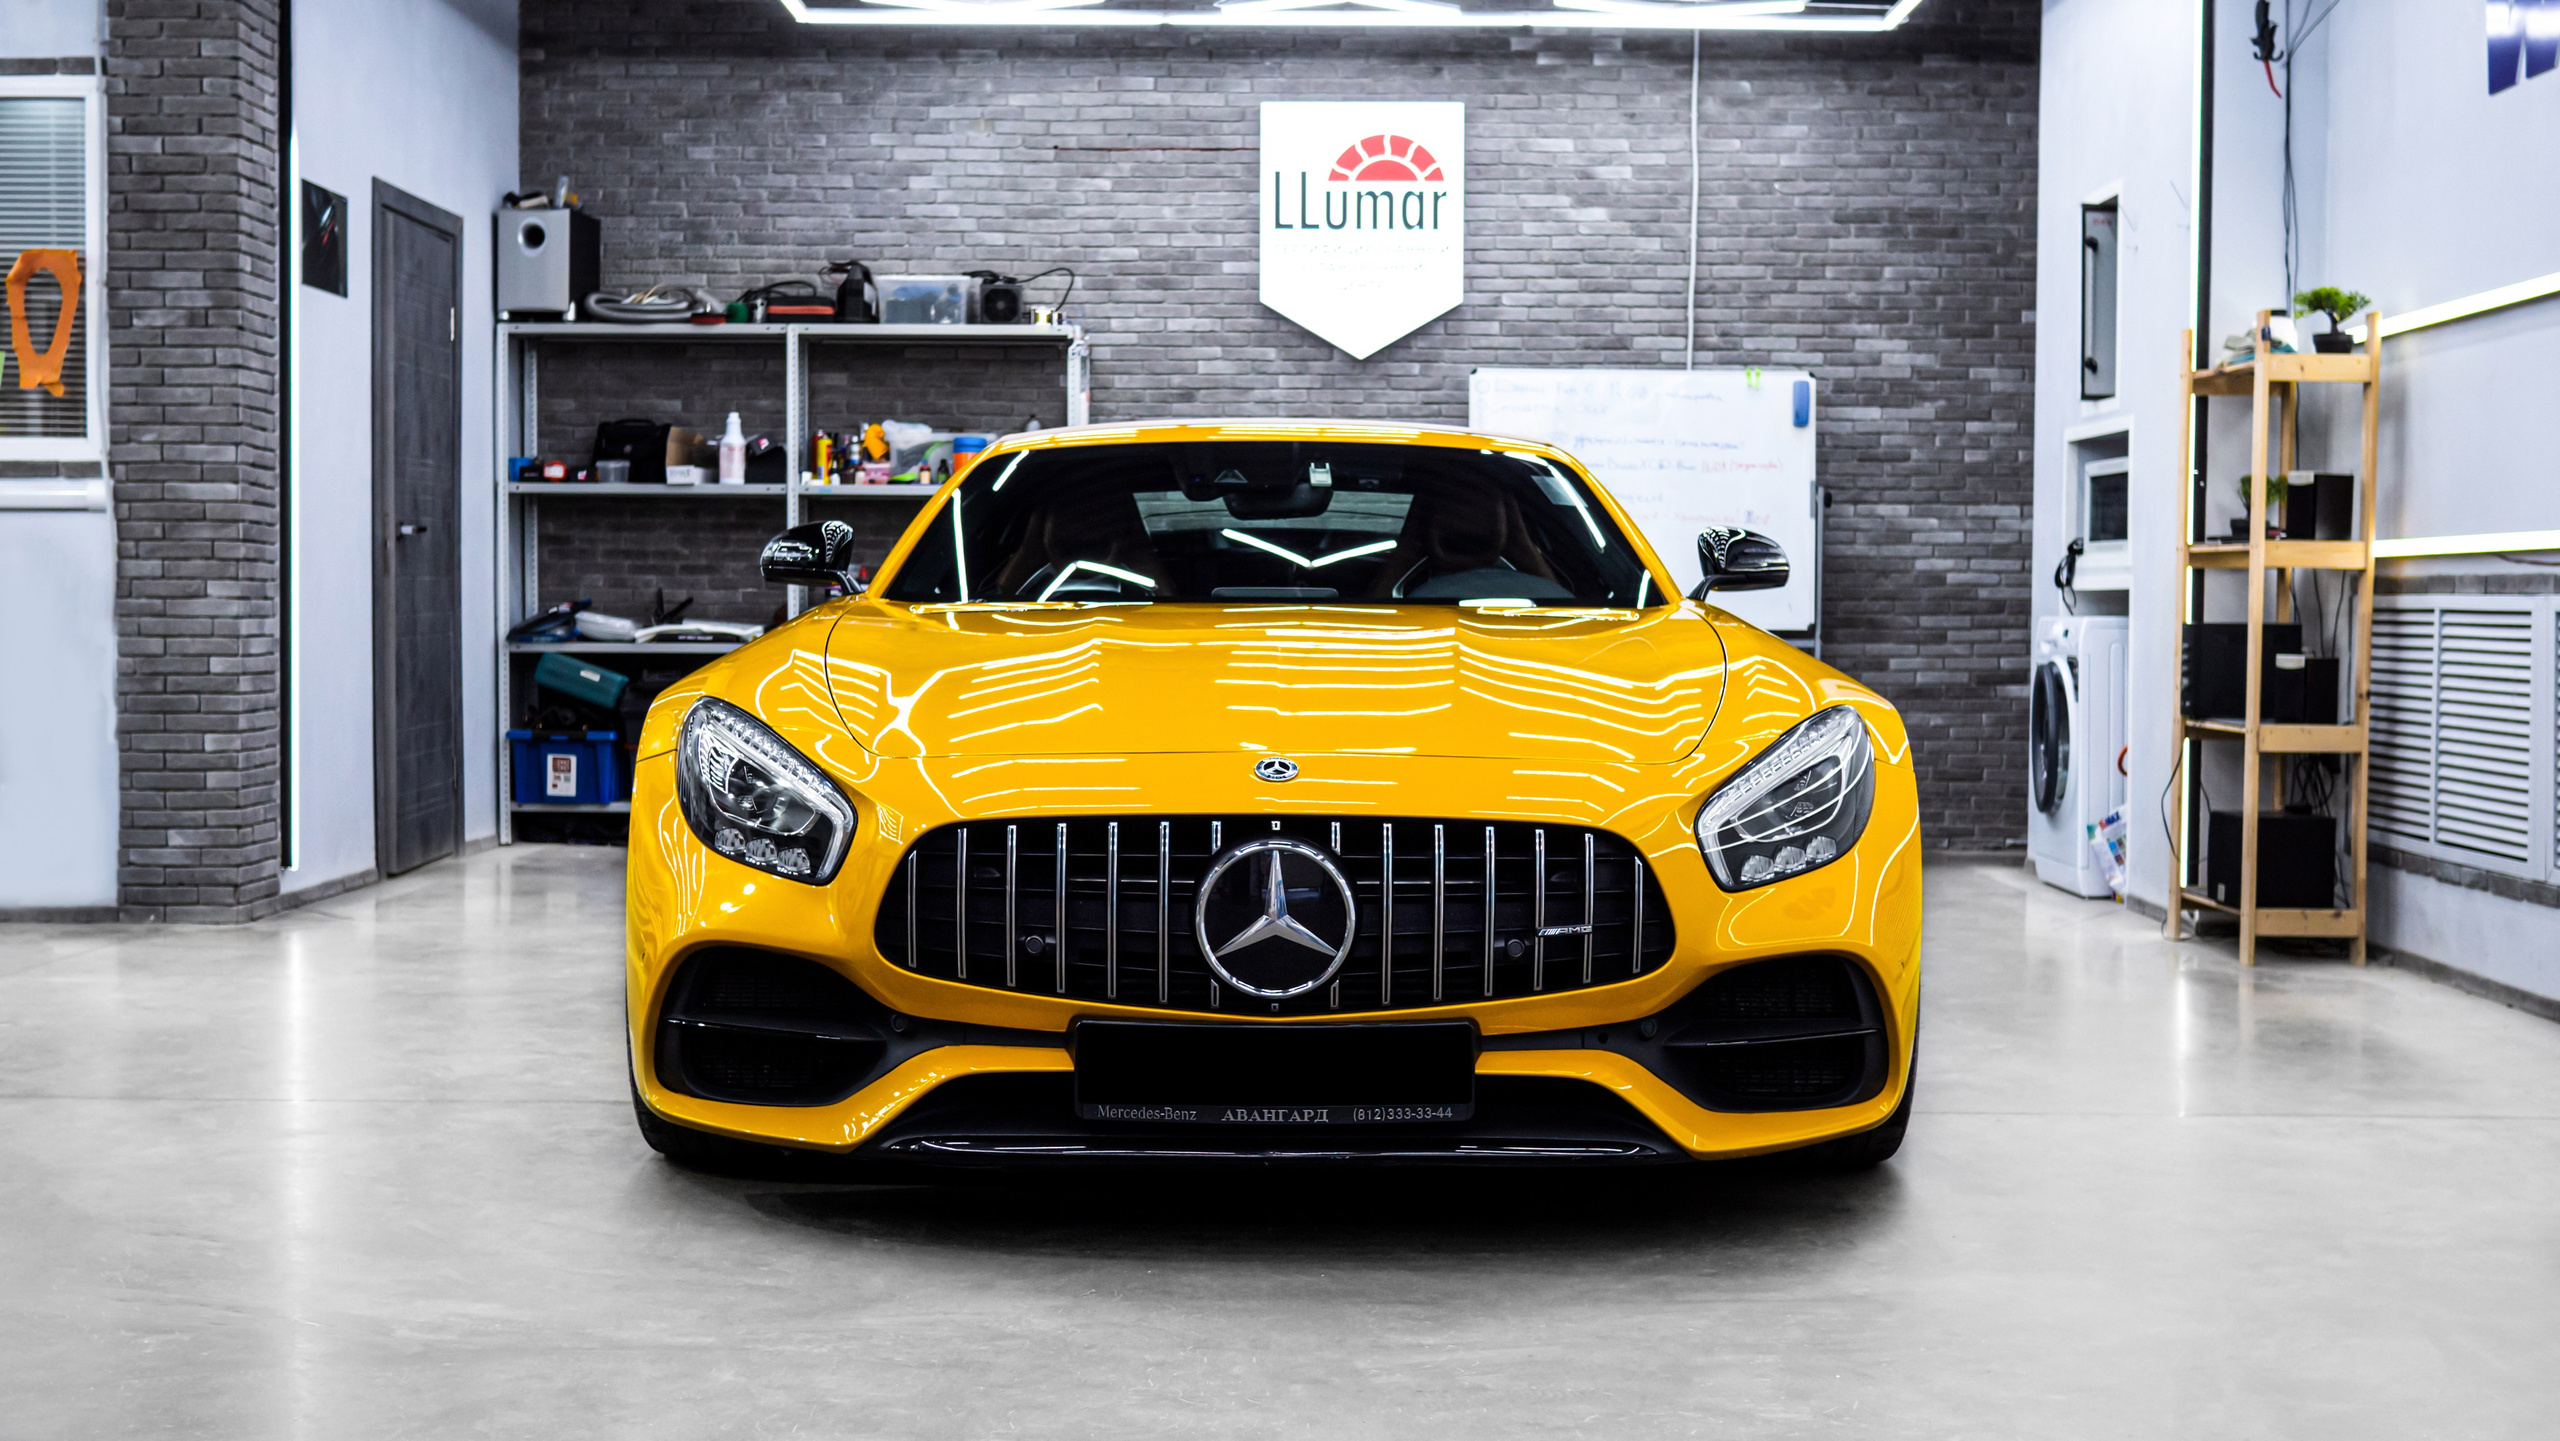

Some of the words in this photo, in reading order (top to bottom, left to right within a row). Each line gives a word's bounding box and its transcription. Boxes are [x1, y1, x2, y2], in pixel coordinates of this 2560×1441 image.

[1274, 171, 1447, 230] LLumar
[1557, 925, 1592, 934] AMG
[1097, 1105, 1197, 1121] Mercedes-Benz
[1221, 1108, 1329, 1124] АВАНГАРД
[1353, 1106, 1453, 1122] (812)333-33-44
